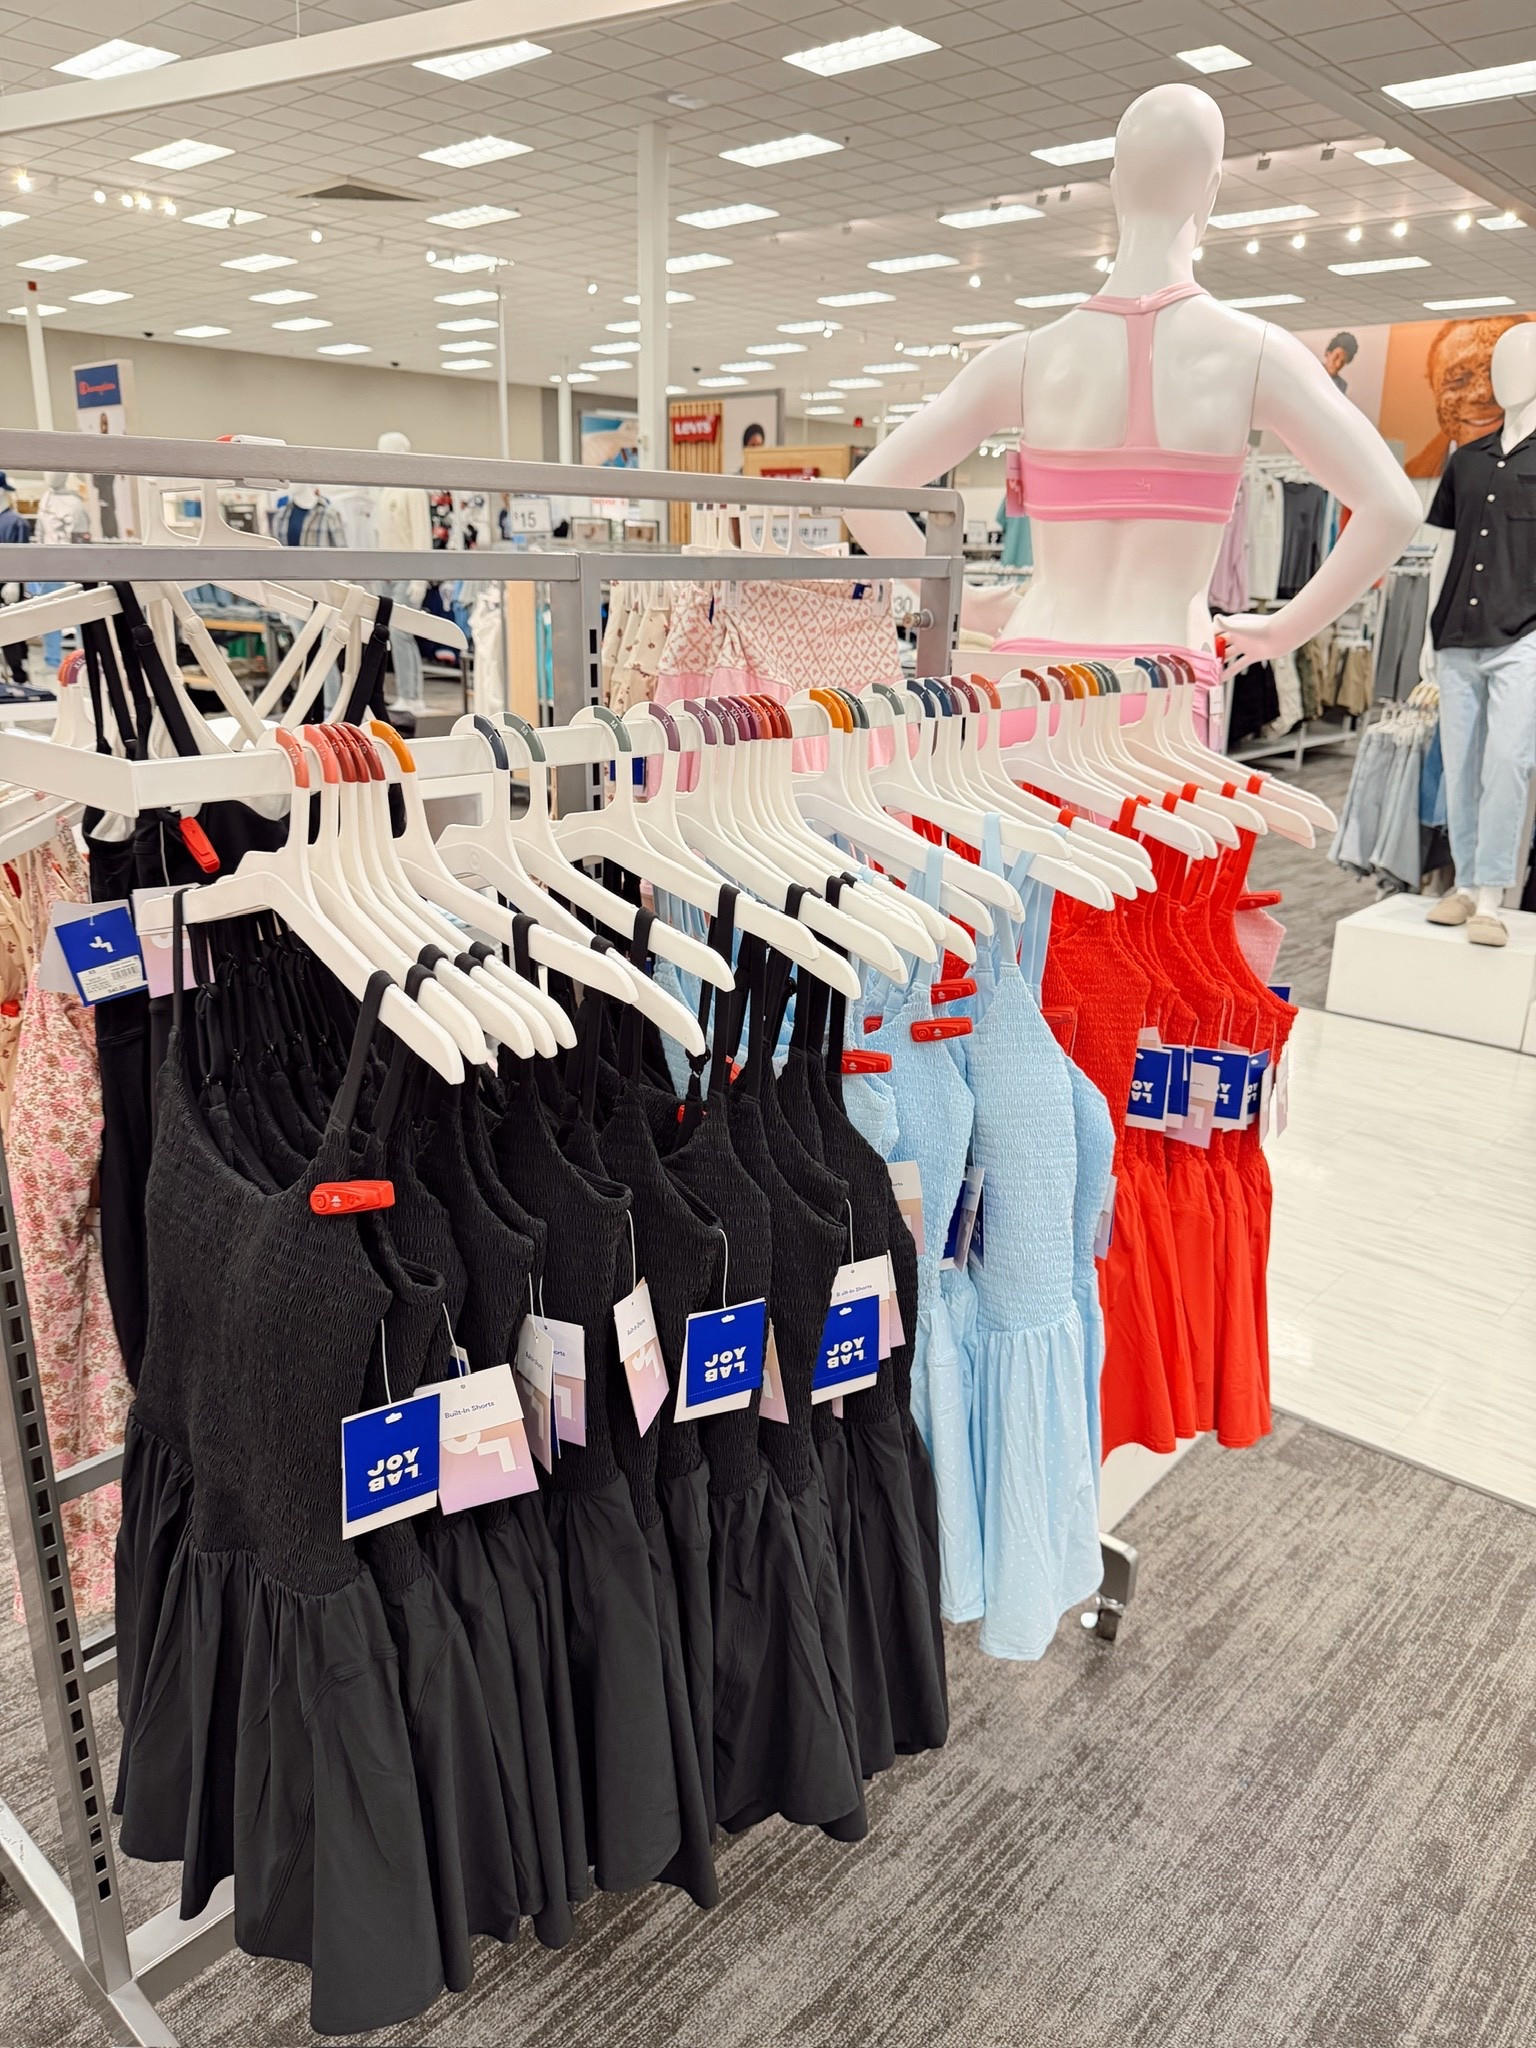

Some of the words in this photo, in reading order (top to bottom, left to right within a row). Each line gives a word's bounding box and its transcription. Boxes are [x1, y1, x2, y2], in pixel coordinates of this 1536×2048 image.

[662, 716, 670, 729] XL
[697, 710, 705, 723] XL
[718, 712, 725, 724] XL
[1131, 1080, 1154, 1093] OY
[1131, 1091, 1153, 1104] LA
[826, 1336, 865, 1357] JOY
[553, 1350, 566, 1358] orts
[704, 1345, 747, 1368] JOY
[444, 1407, 471, 1419] Built-In
[471, 1401, 496, 1412] Shorts
[367, 1446, 420, 1477] JOY
